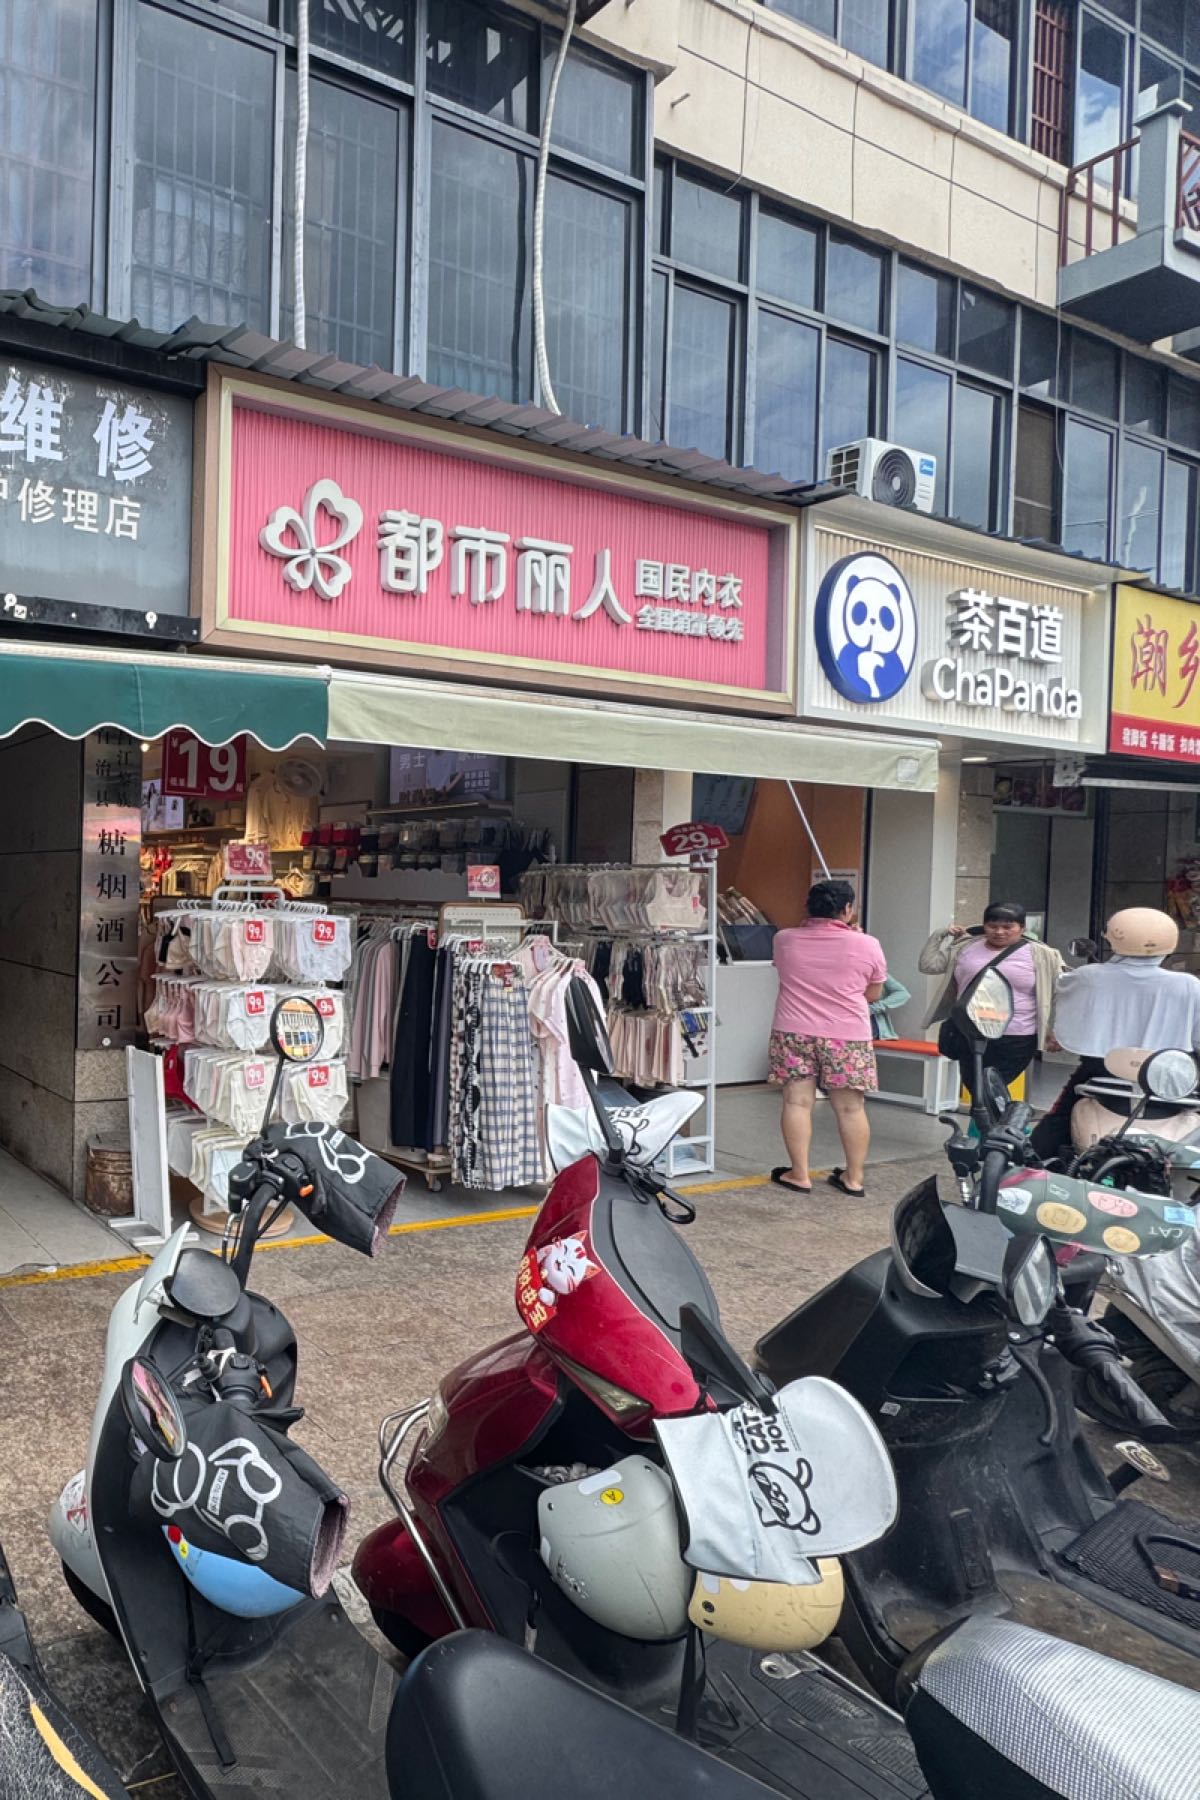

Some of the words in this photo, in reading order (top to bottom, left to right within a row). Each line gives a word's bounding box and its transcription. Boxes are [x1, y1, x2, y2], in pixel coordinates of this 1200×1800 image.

[377, 508, 632, 625] 都市丽人
[634, 558, 743, 609] 国民内衣
[950, 587, 1063, 664] 茶百道
[929, 657, 1083, 721] ChaPanda
[95, 828, 128, 1031] 糖烟酒公司
